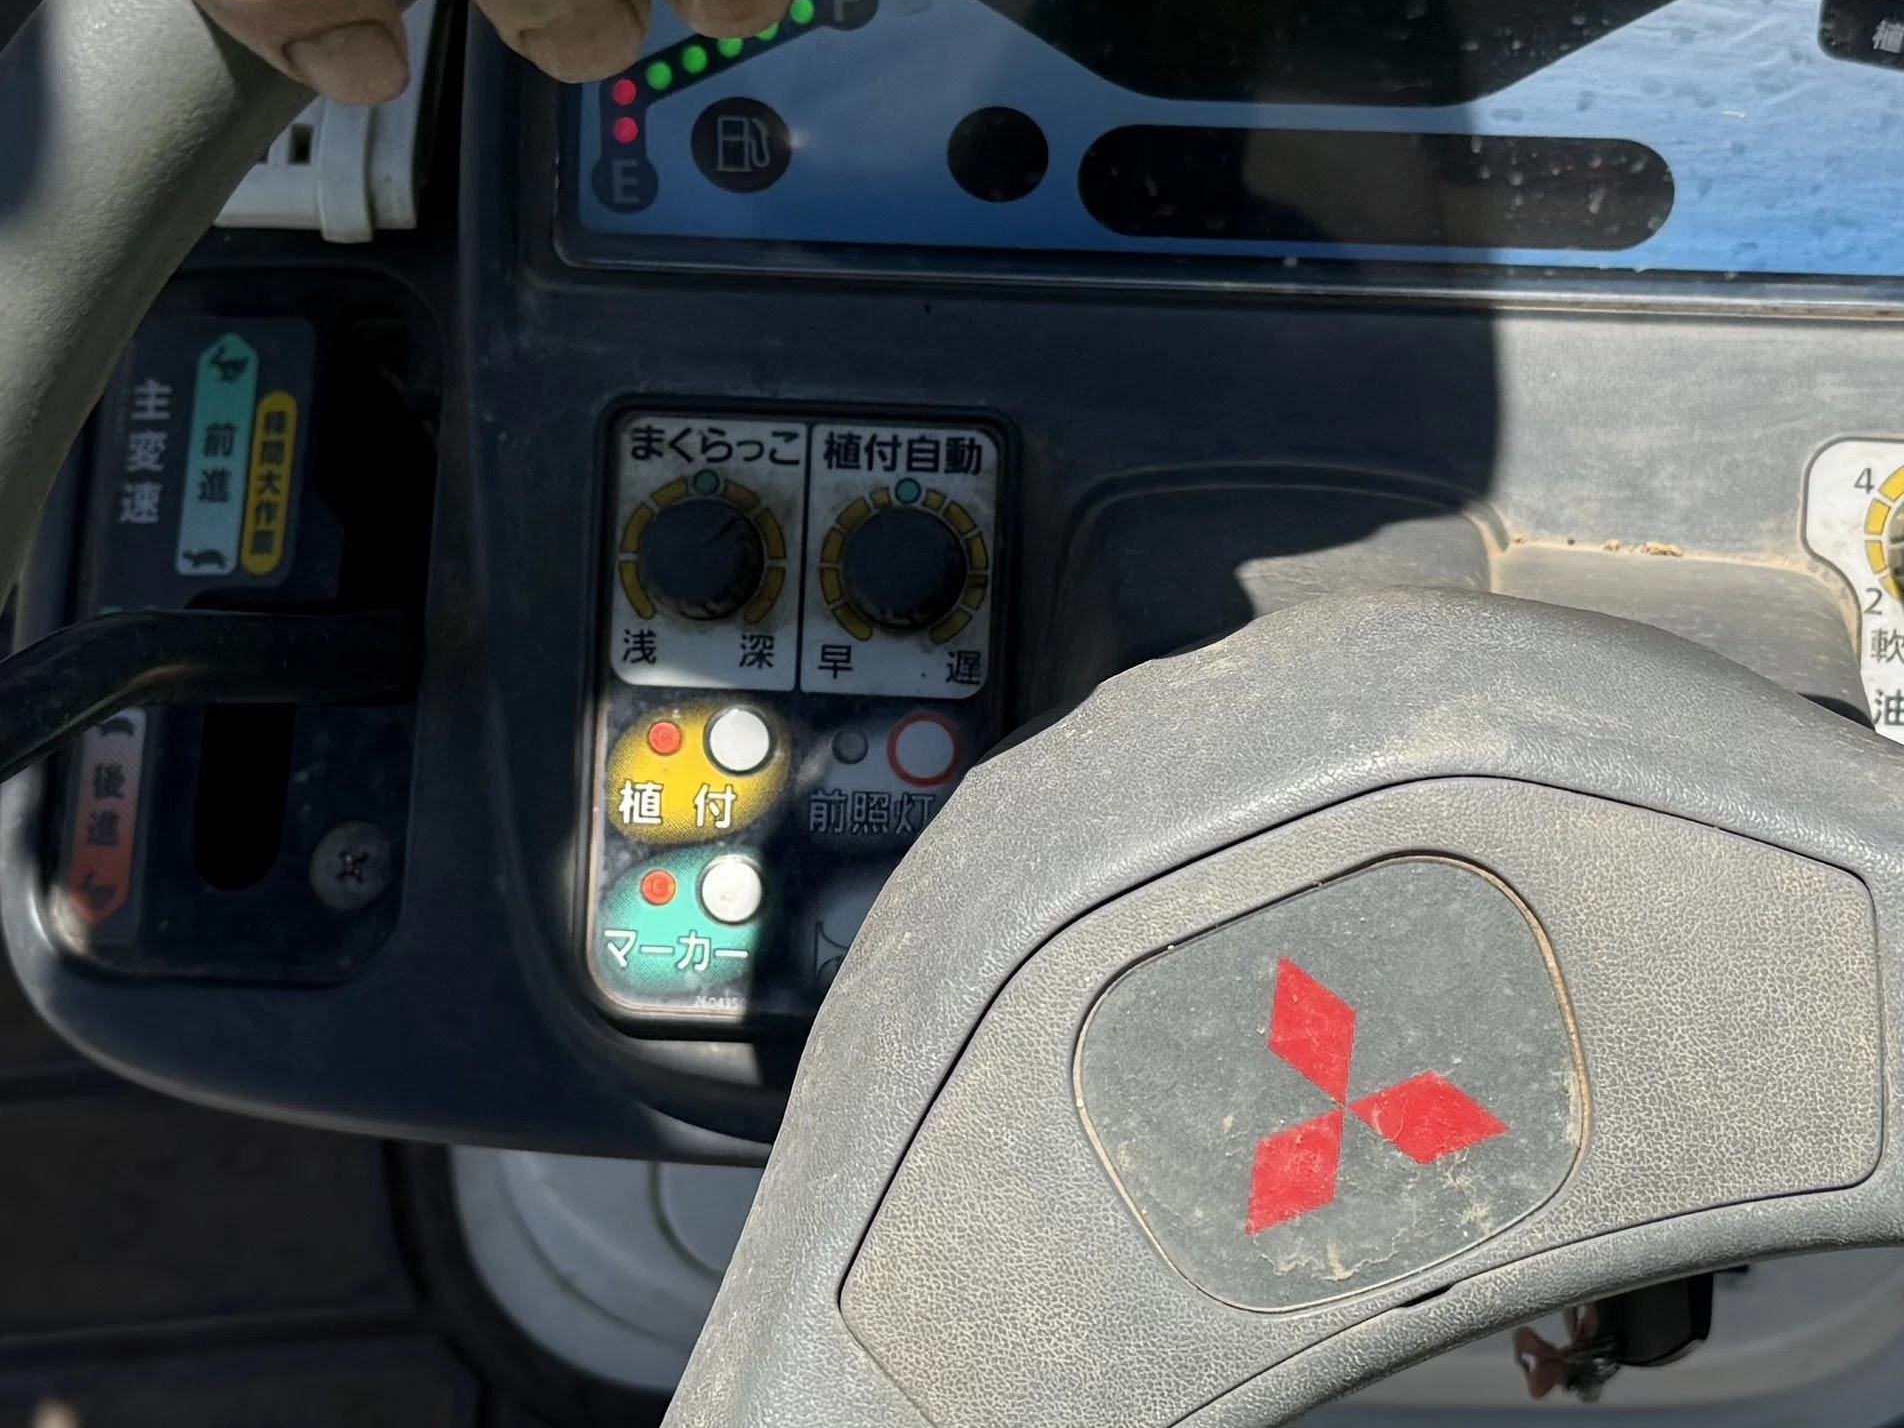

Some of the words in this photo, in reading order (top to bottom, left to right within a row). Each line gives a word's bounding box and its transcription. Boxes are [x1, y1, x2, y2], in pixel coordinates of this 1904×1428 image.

[612, 158, 640, 204] E
[119, 377, 174, 524] 主変速
[630, 425, 800, 465] まくらっこ
[823, 431, 983, 475] 植付自動
[1853, 467, 1875, 495] 4
[1863, 587, 1884, 616] 2
[622, 628, 658, 665] 浅
[739, 633, 776, 669] 深
[817, 643, 854, 679] 早
[945, 649, 983, 686] 遅
[618, 779, 738, 830] 植付
[808, 788, 936, 835] 前照灯
[602, 928, 750, 974] マーカー
